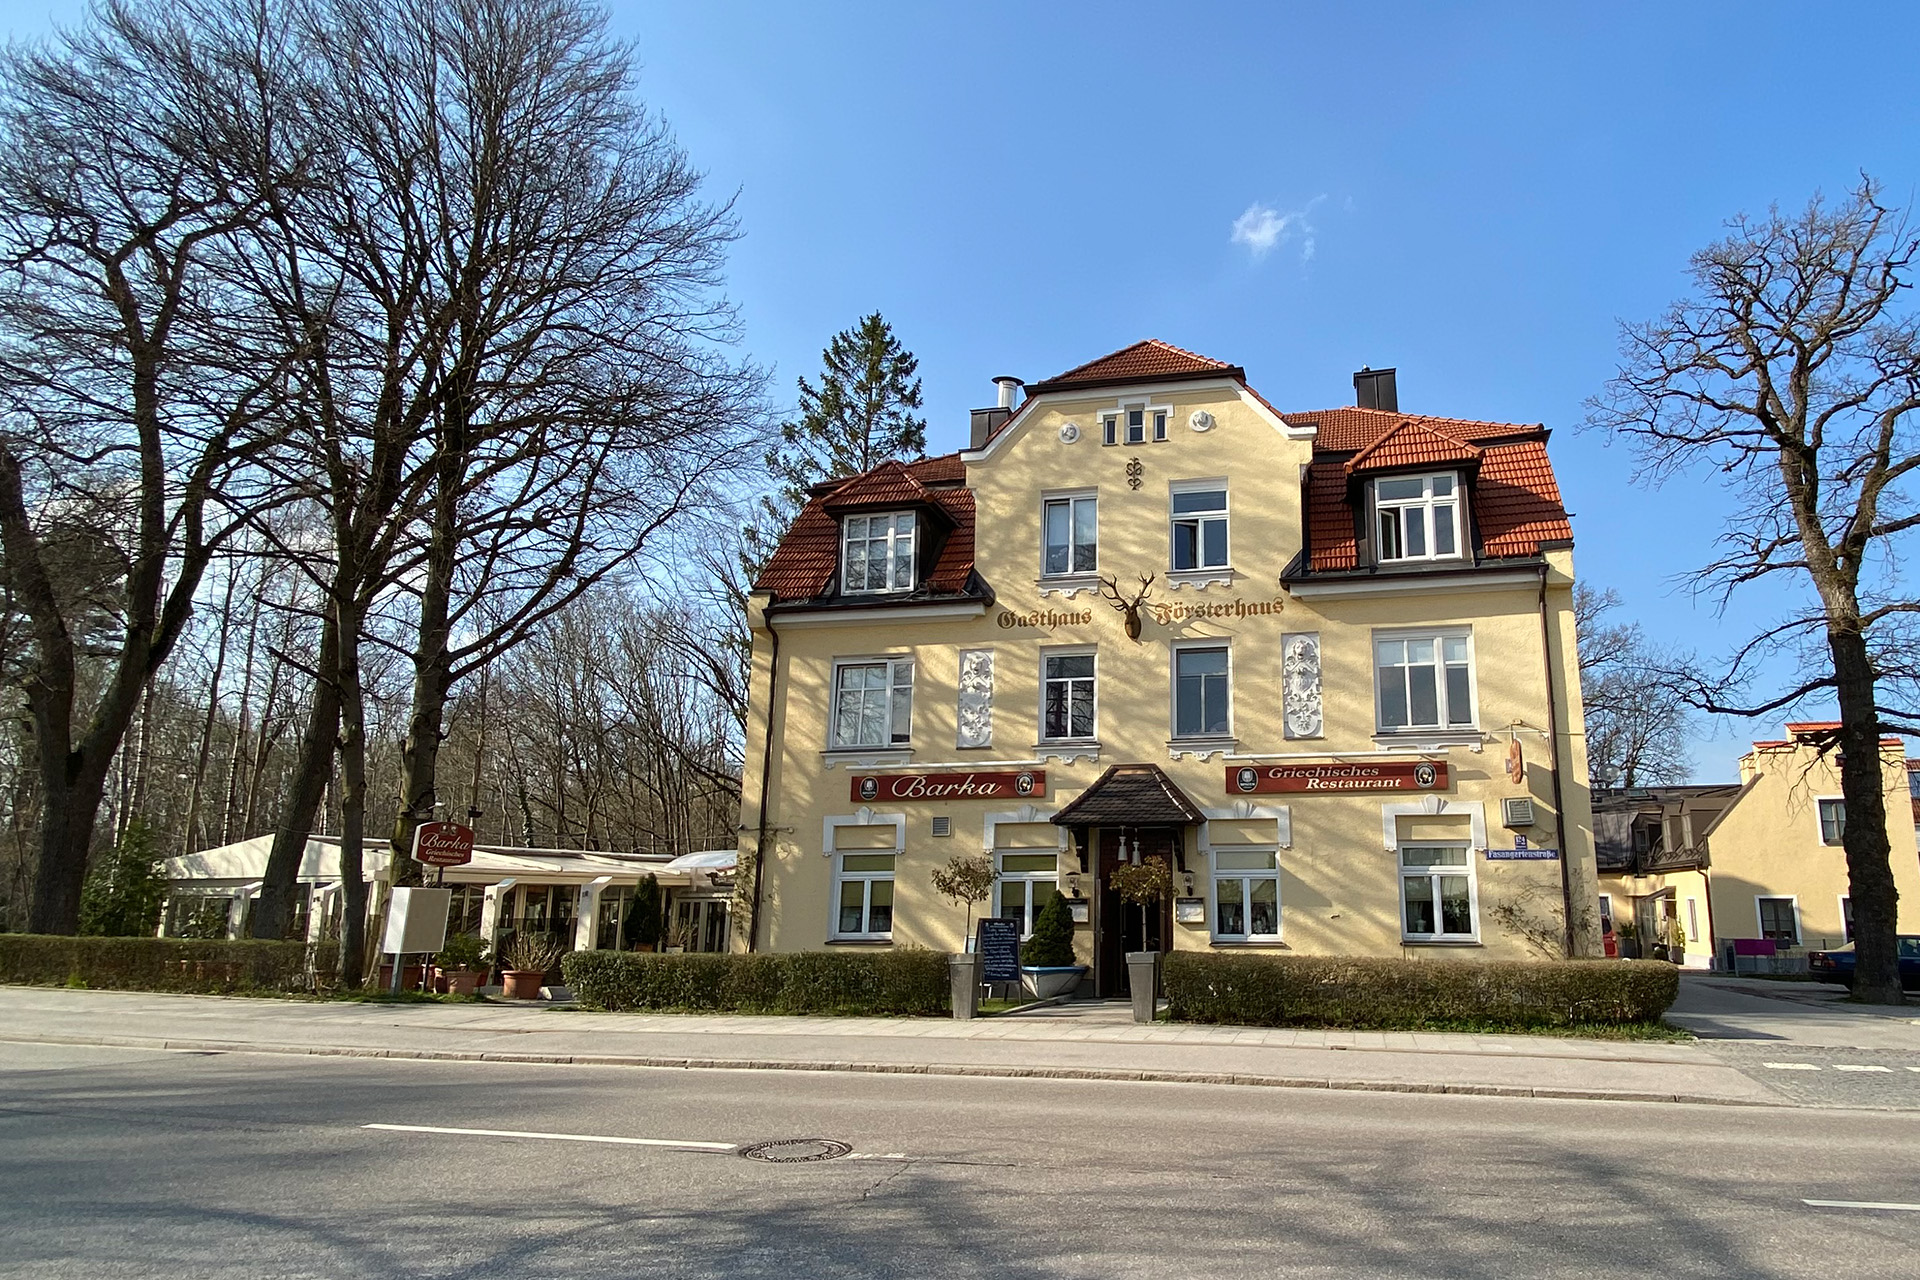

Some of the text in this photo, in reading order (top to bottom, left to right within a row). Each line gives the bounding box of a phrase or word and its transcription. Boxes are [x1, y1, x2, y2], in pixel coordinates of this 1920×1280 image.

[997, 597, 1285, 631] Gasthaus Försterhaus
[1268, 766, 1379, 779] Griechisches
[891, 774, 1002, 798] Barka
[1305, 778, 1402, 790] Restaurant
[420, 833, 470, 850] Barka
[425, 849, 465, 858] Griechisches
[428, 856, 462, 864] Restaurant
